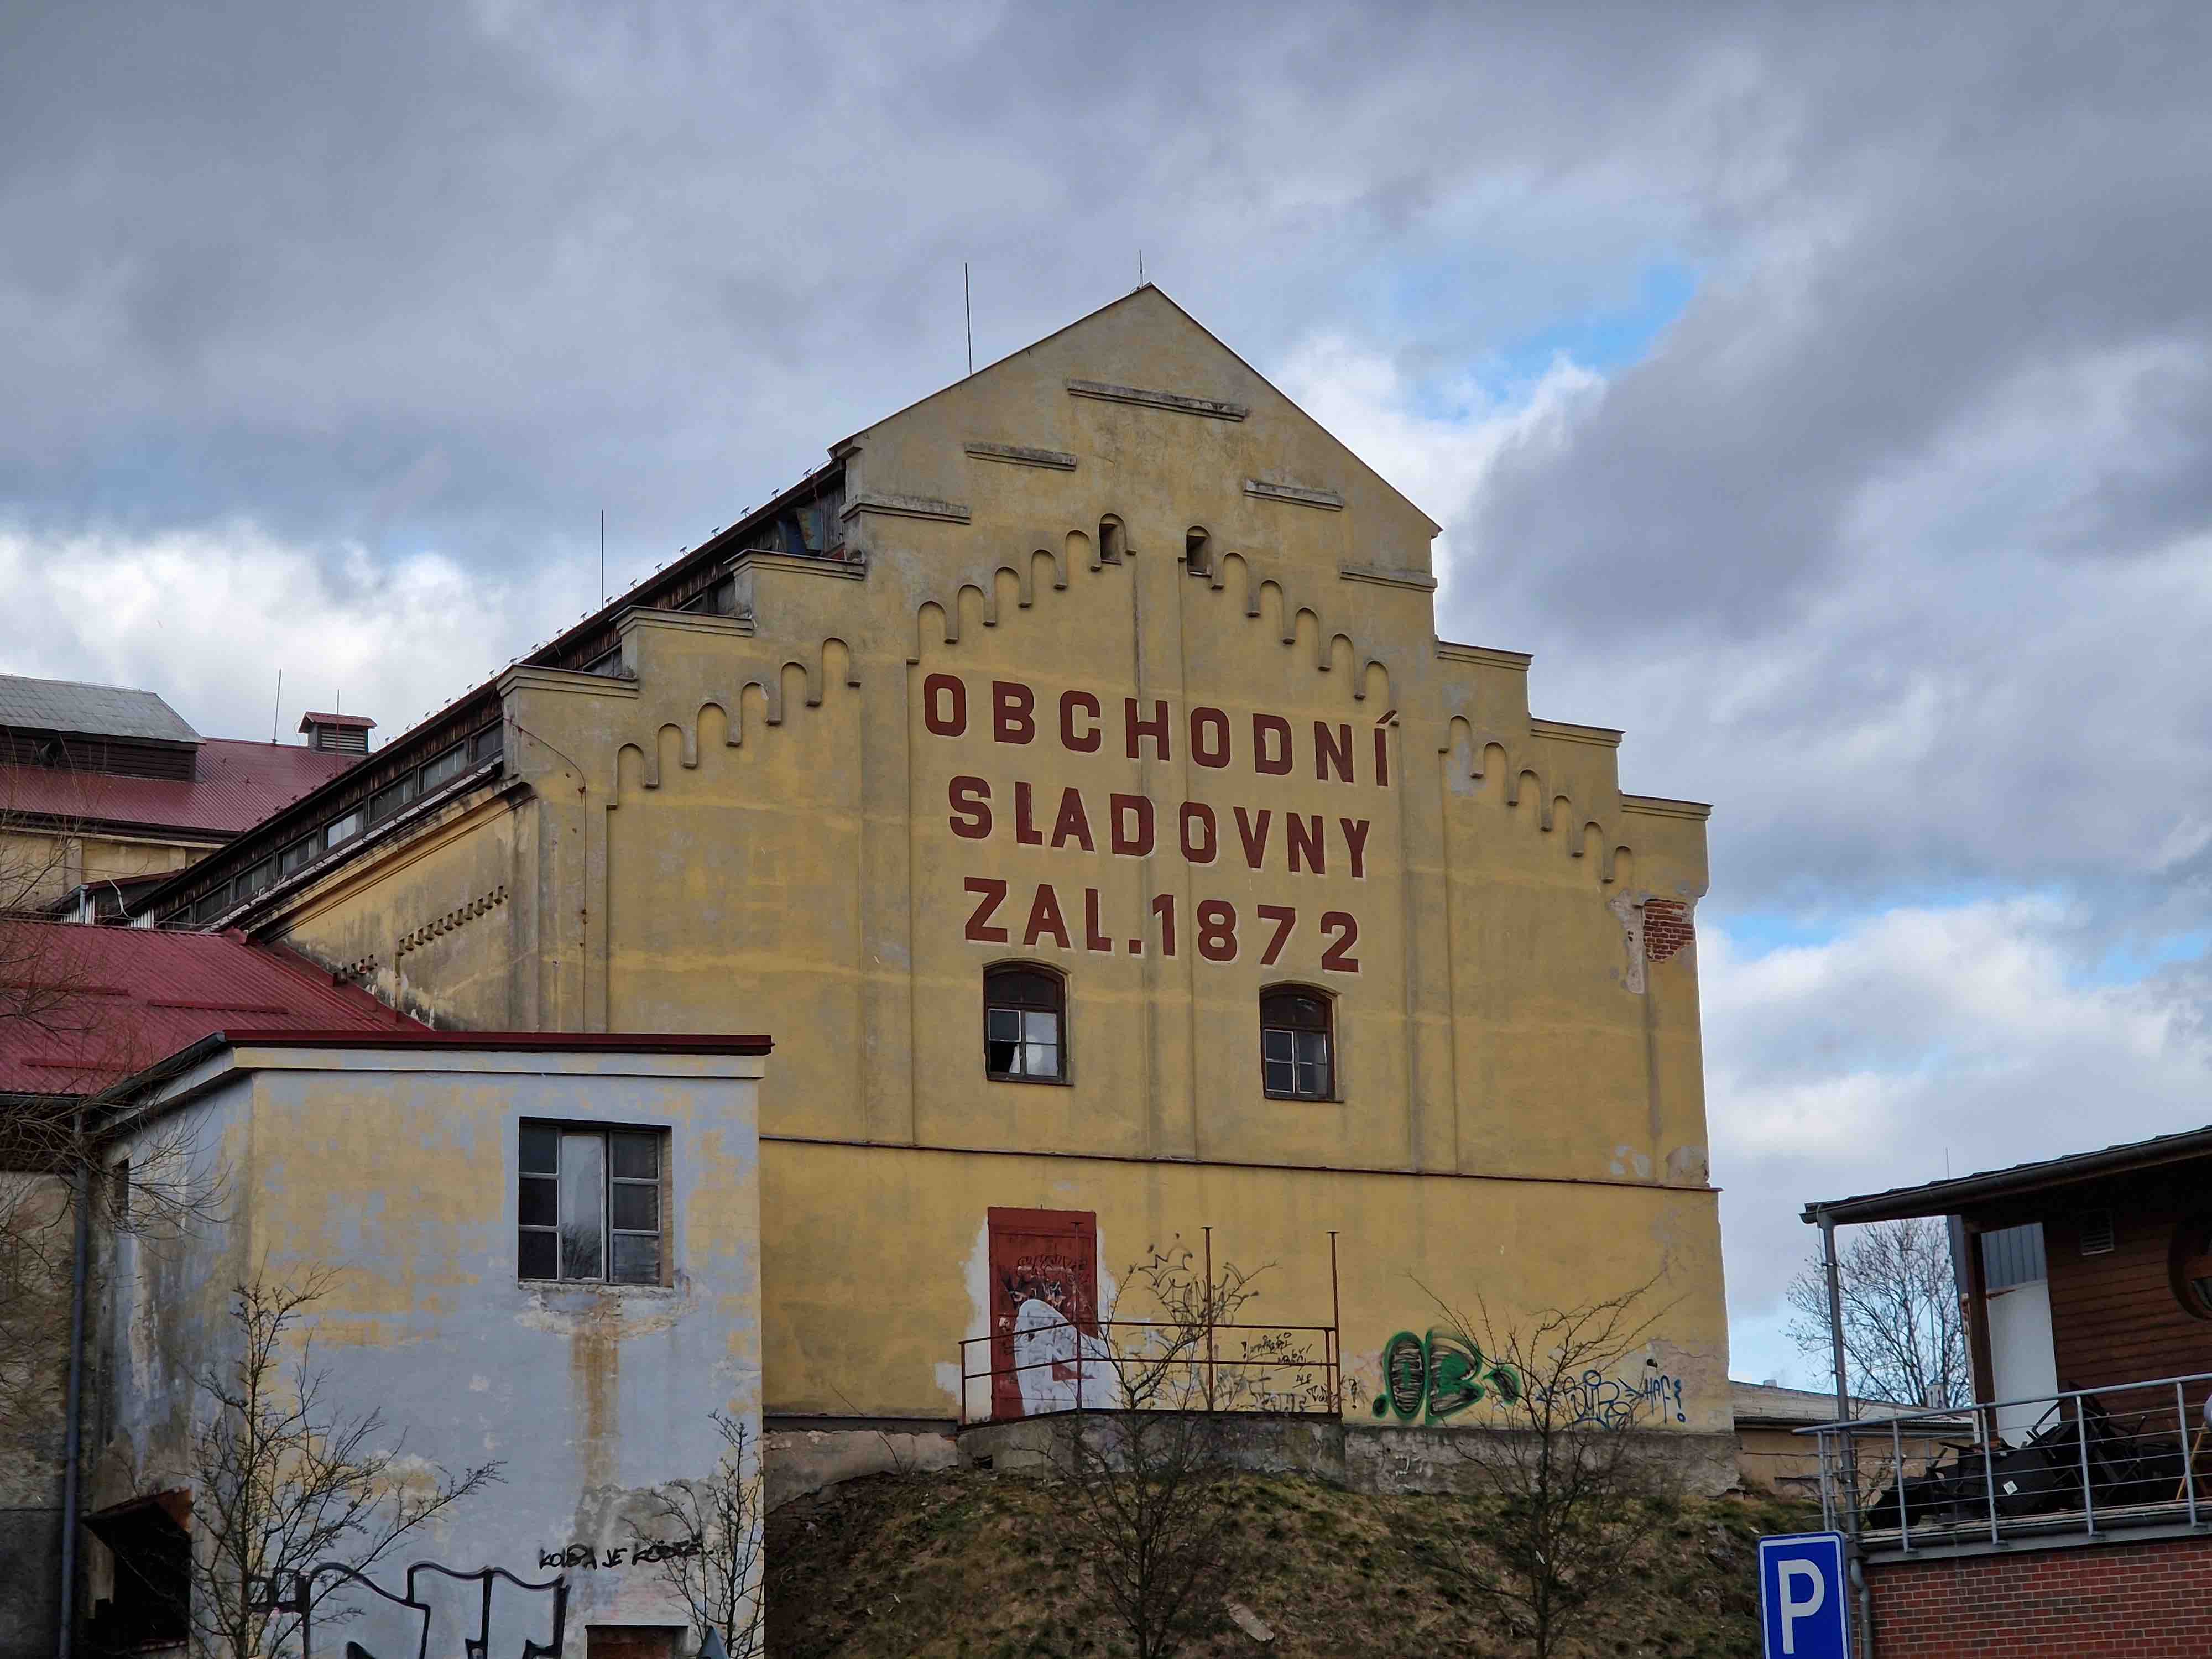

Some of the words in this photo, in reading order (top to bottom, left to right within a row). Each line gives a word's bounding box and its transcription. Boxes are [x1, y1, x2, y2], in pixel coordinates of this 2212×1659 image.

[924, 673, 1398, 787] OBCHODNÍ
[948, 775, 1370, 879] SLADOVNY
[1778, 1559, 1825, 1654] P
